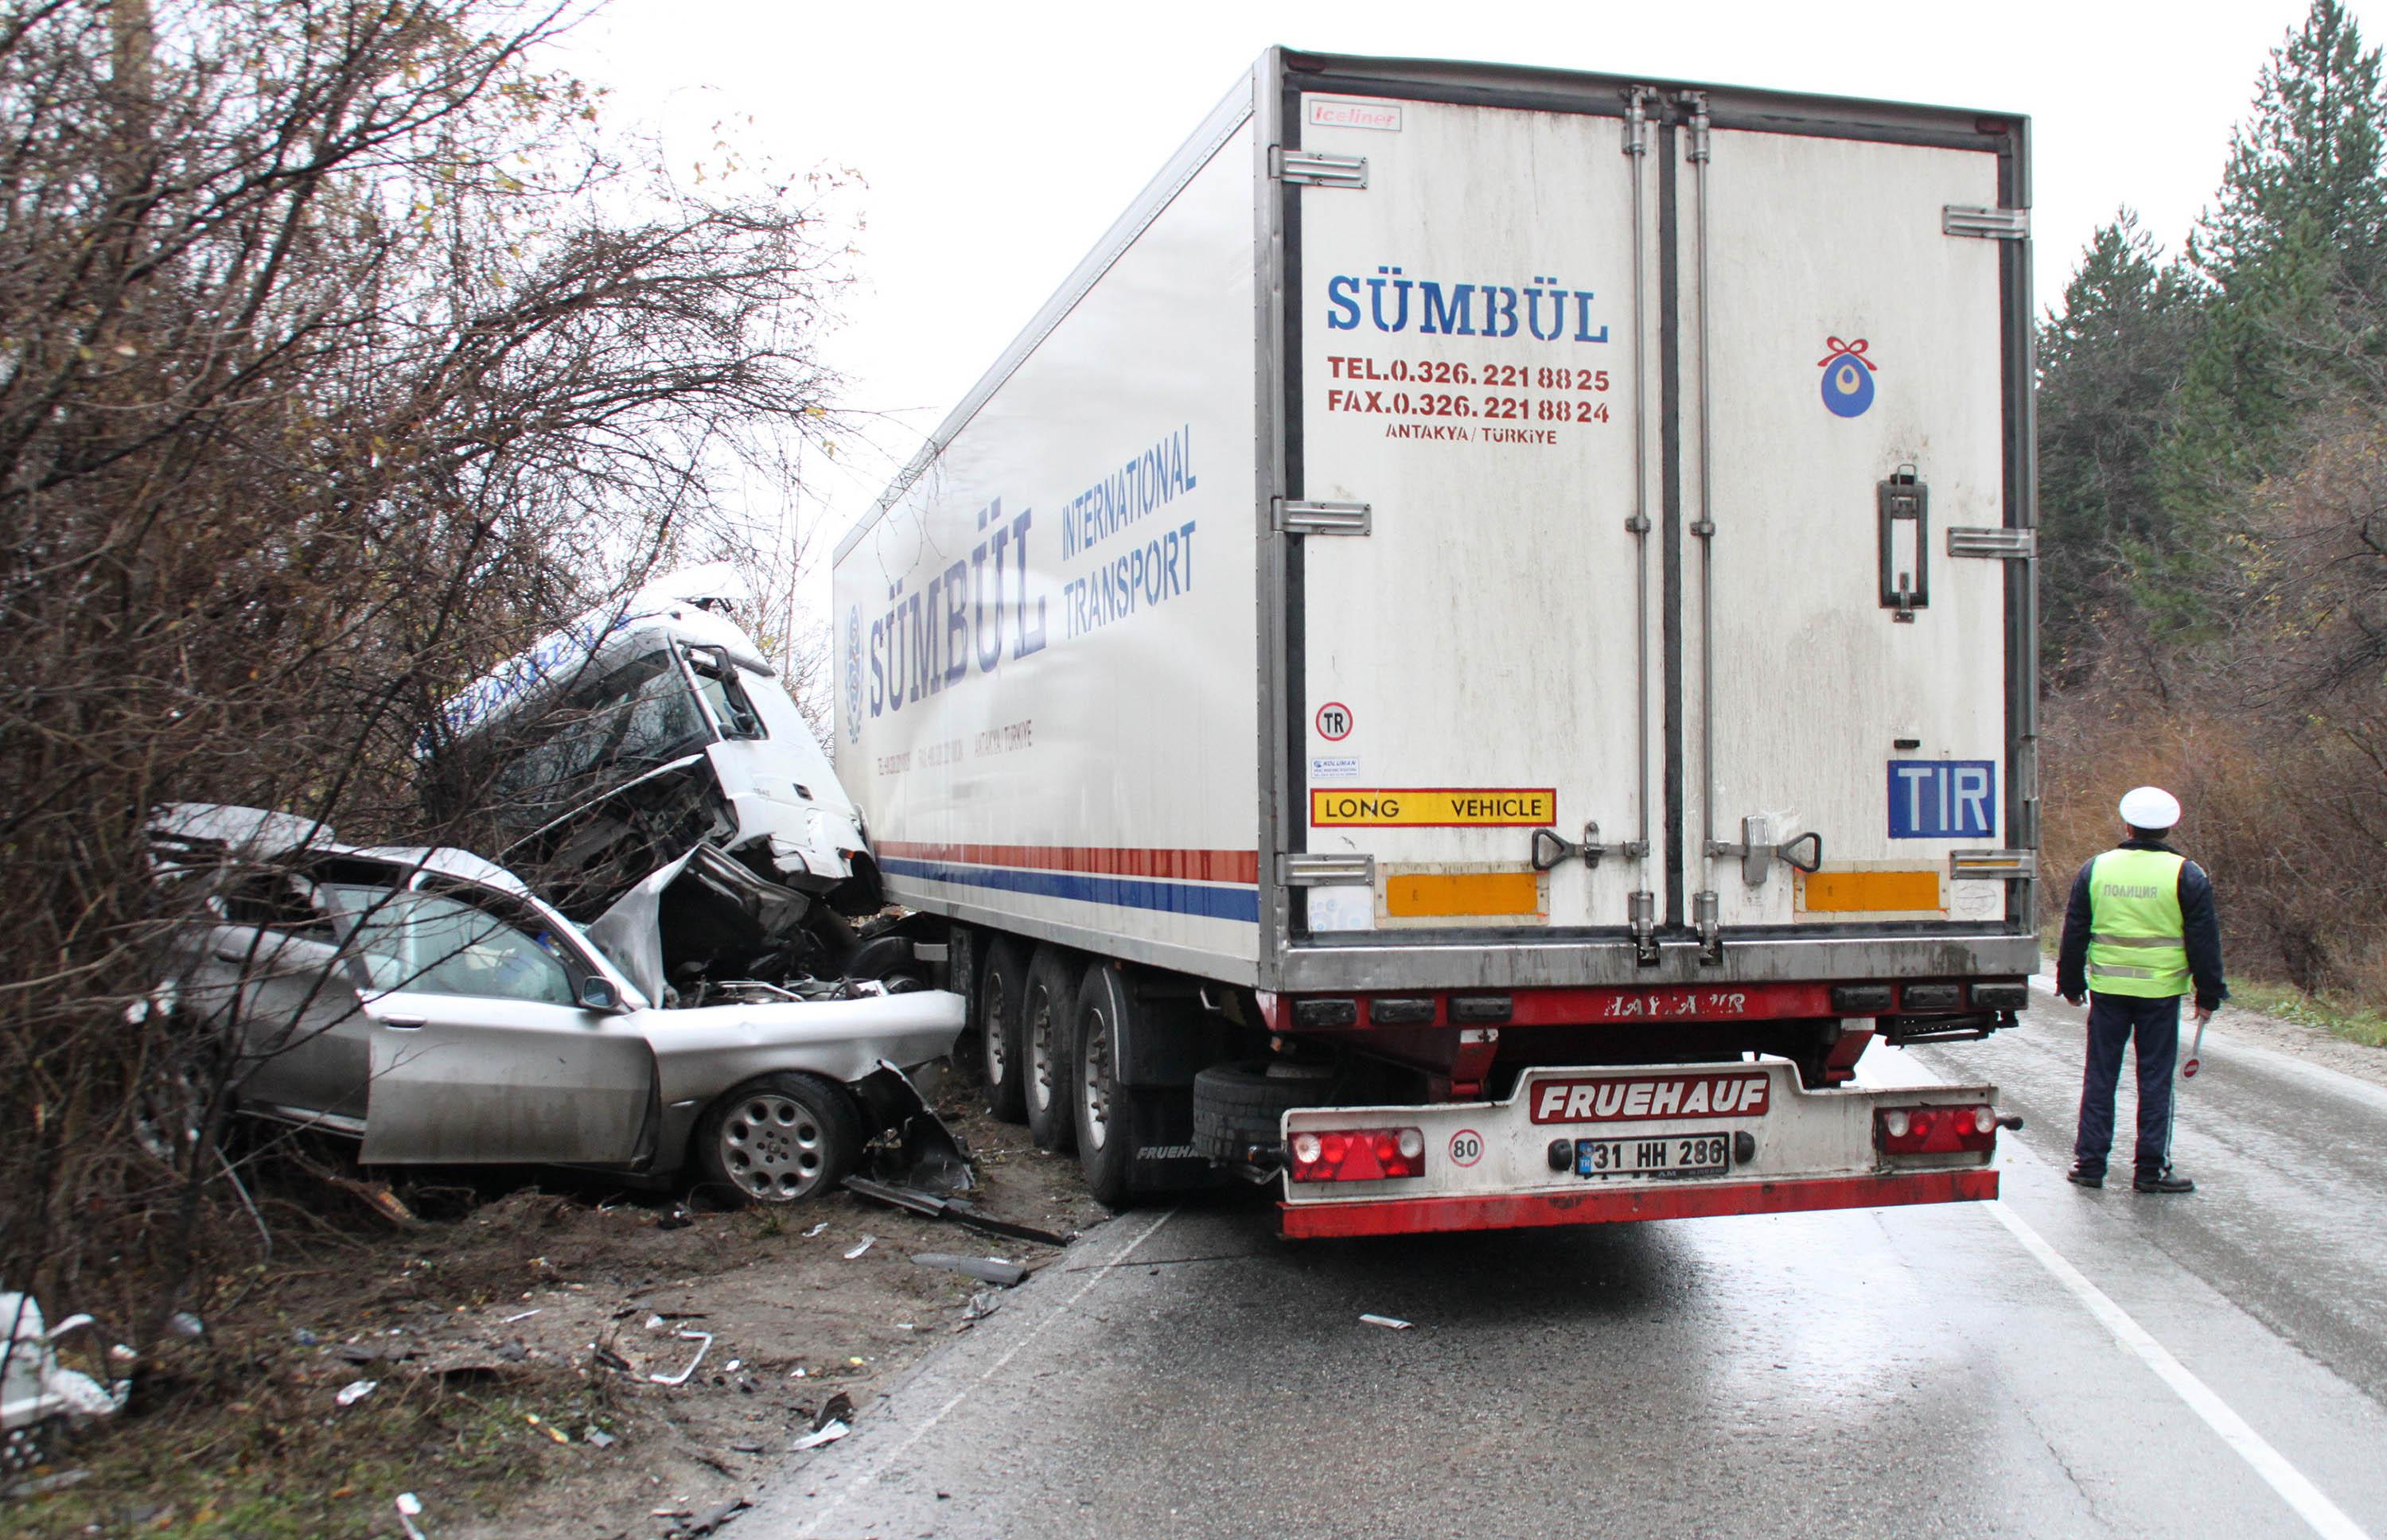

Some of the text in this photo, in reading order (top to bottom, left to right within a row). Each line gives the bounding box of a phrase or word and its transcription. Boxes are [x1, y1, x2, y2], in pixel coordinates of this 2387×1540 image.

[1328, 265, 1609, 343] SÜMBÜL
[1482, 364, 1528, 388] 221
[1537, 367, 1571, 390] 88
[1577, 369, 1609, 392] 25
[1484, 397, 1528, 420] 221
[1538, 399, 1571, 422] 88
[1577, 401, 1609, 423] 24
[1063, 423, 1197, 562] INTERNATIONAL
[1063, 520, 1197, 640] TRANSPORT
[870, 496, 1047, 718] SÜMBÜL
[1323, 712, 1344, 733] TR
[1326, 799, 1542, 818] LONG VEHICLE
[1898, 767, 1988, 831] TIR
[2103, 884, 2158, 899] ПОЛИЦИЯ
[1538, 1079, 1768, 1119] FRUEHAUF
[1454, 1140, 1478, 1158] 80
[1594, 1143, 1622, 1169] 31
[1637, 1142, 1667, 1168] HH
